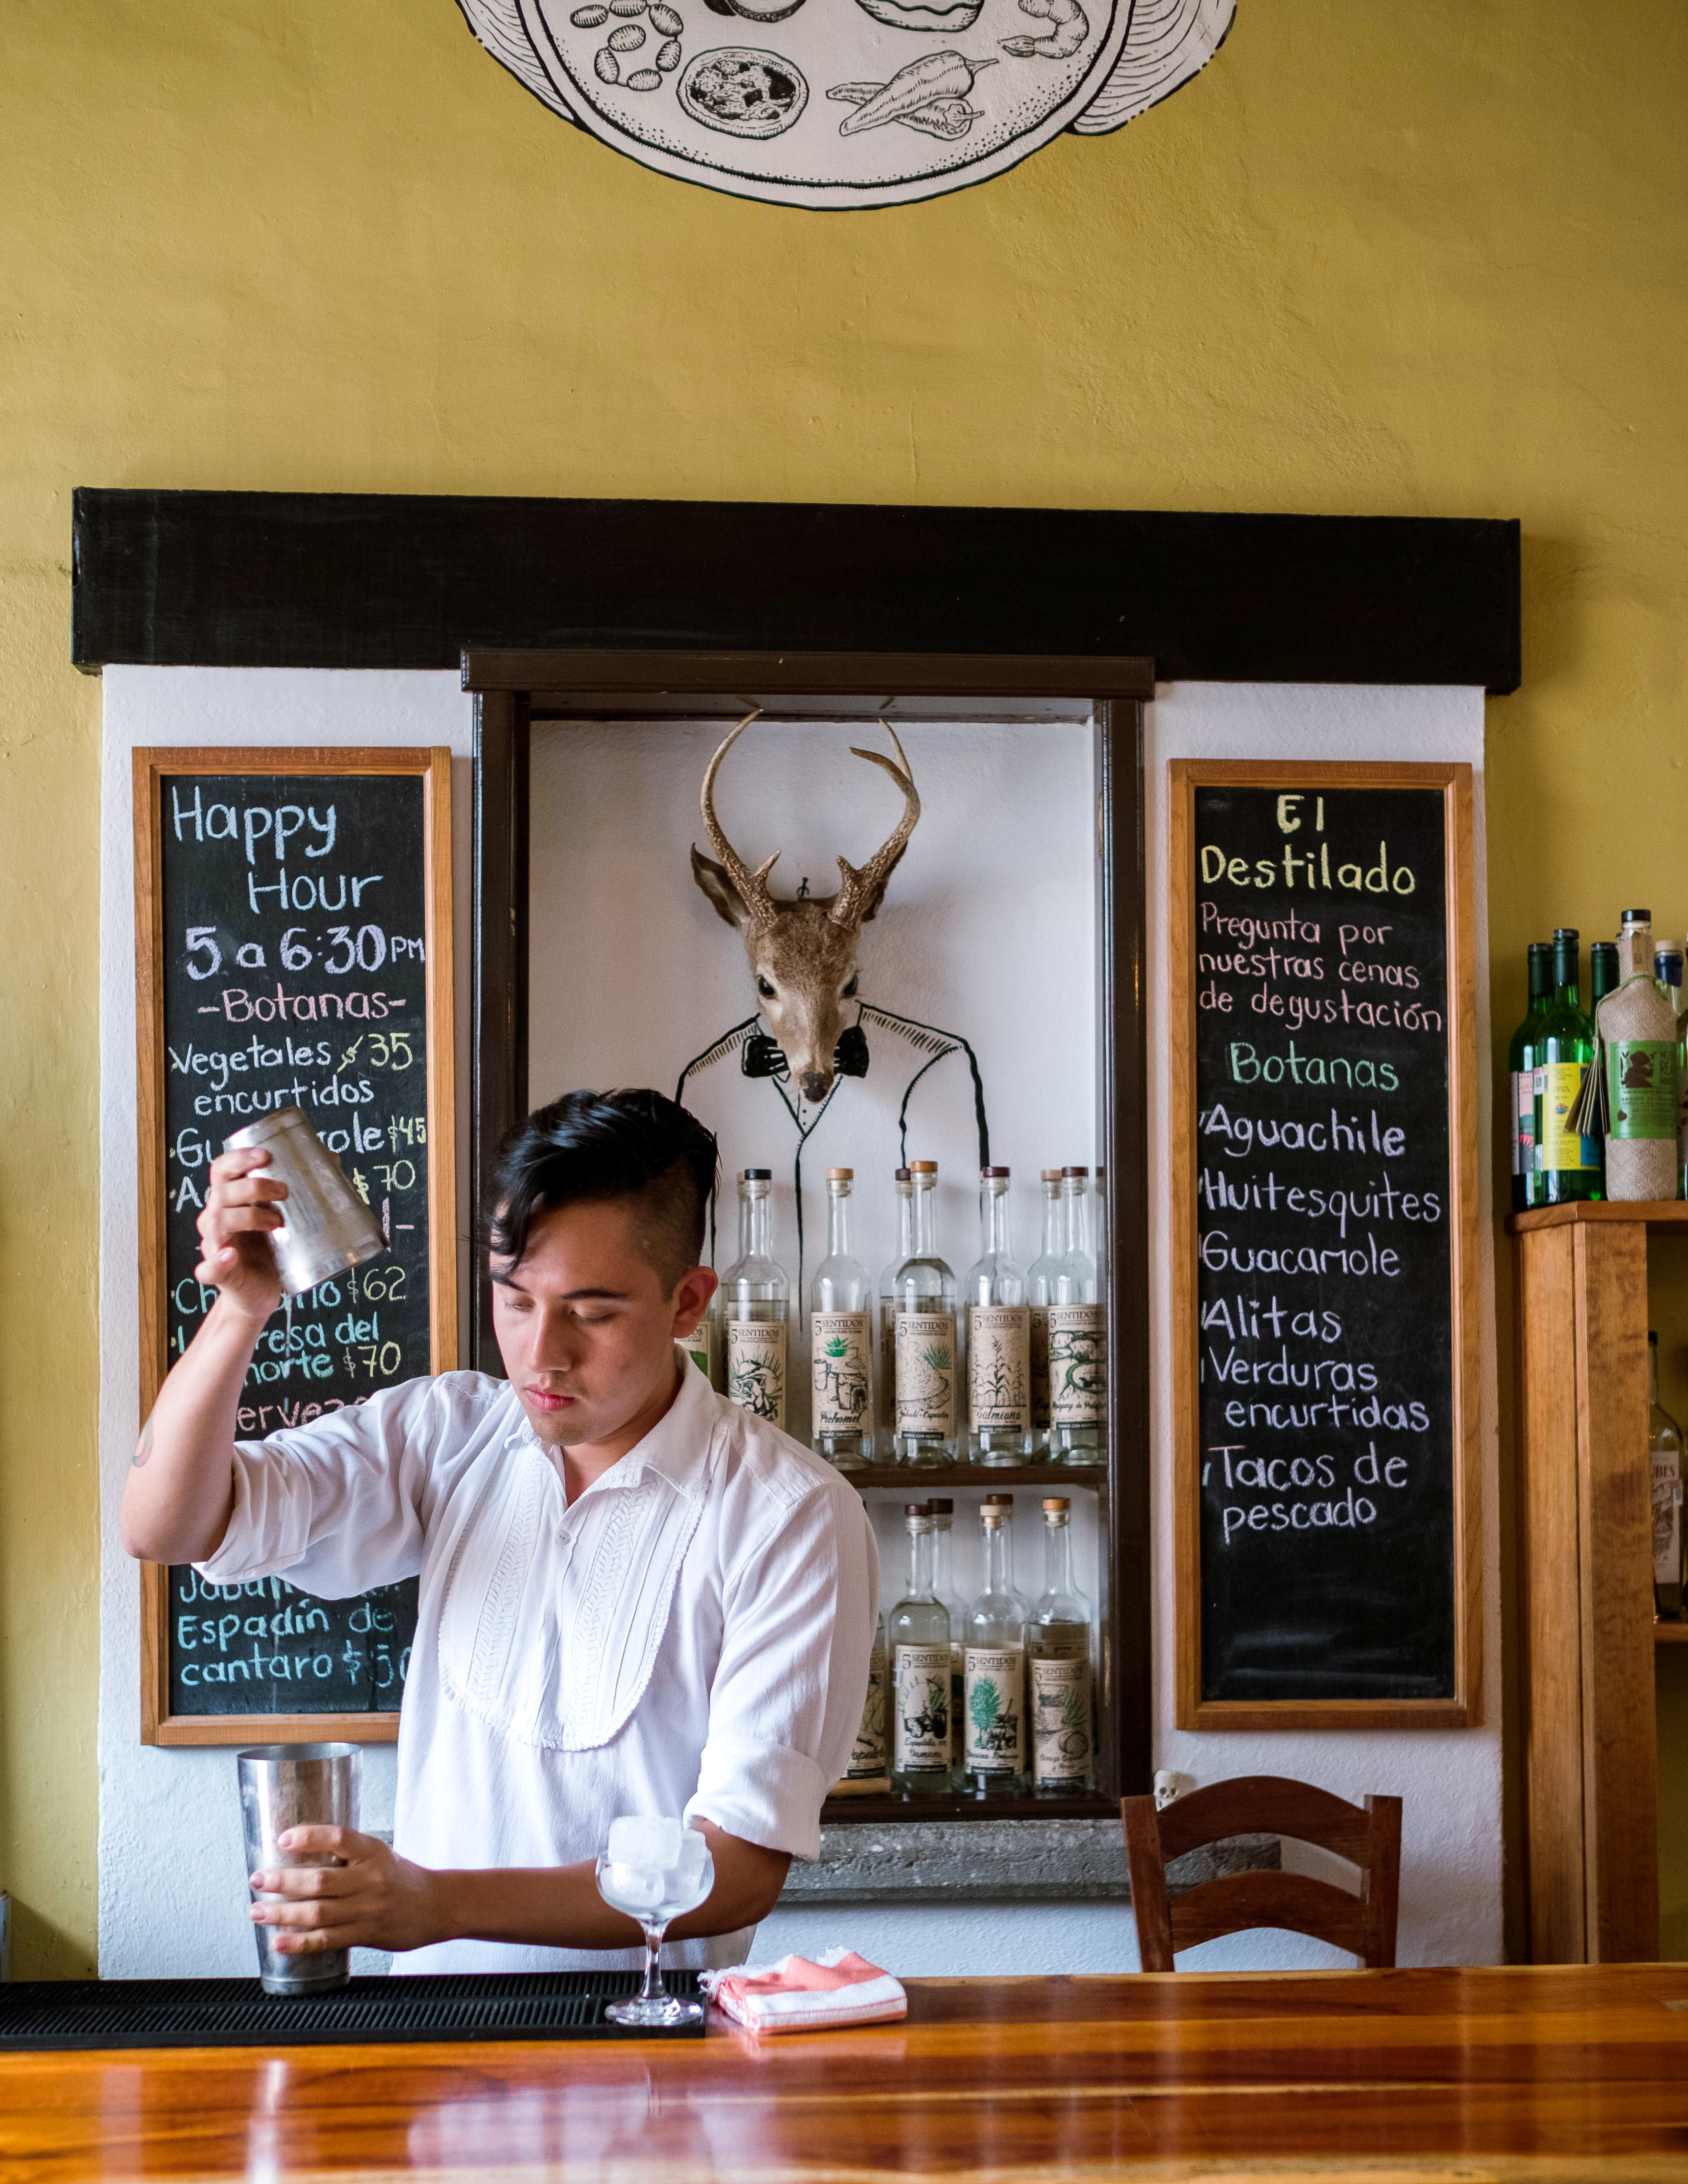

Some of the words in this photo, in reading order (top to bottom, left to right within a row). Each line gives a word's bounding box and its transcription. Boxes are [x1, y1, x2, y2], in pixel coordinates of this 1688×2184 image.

[173, 786, 337, 865] Happy
[1277, 795, 1324, 834] El
[248, 867, 383, 913] Hour
[1201, 841, 1415, 895] Destilado
[1200, 902, 1320, 950] Pregunta
[1339, 924, 1392, 956] por
[186, 925, 222, 980] 5
[236, 942, 267, 968] a
[1199, 947, 1324, 979] nuestras
[1339, 960, 1420, 989] cenas
[1199, 981, 1233, 1012] de
[1252, 982, 1441, 1031] degustación
[169, 1035, 331, 1091] Vegetales
[1231, 1040, 1399, 1091] Botanas
[194, 1074, 375, 1116] encurtidos
[1205, 1104, 1405, 1157] Aguachile
[1204, 1168, 1440, 1238] Huitesquites
[1202, 1231, 1400, 1276] Guacamole
[347, 1266, 407, 1303] $62
[334, 1311, 379, 1344] del
[731, 1329, 738, 1344] 5
[738, 1328, 779, 1337] SENTIDOS
[815, 1321, 821, 1335] 5
[901, 1322, 907, 1336] 5
[974, 1315, 981, 1330] 5
[1050, 1313, 1056, 1328] 5
[1203, 1295, 1341, 1342] Alitas
[344, 1342, 401, 1378] $70
[1209, 1345, 1378, 1391] Verduras
[1224, 1394, 1430, 1432] encurtidas
[1208, 1445, 1335, 1491] Tacos
[1354, 1441, 1408, 1488] de
[1223, 1487, 1377, 1545] pescado
[178, 1598, 329, 1652] Espadín
[349, 1602, 393, 1633] de
[181, 1642, 332, 1686] cantaro
[903, 1654, 911, 1669] 5
[968, 1656, 975, 1671] 5
[1034, 1668, 1042, 1682] 5
